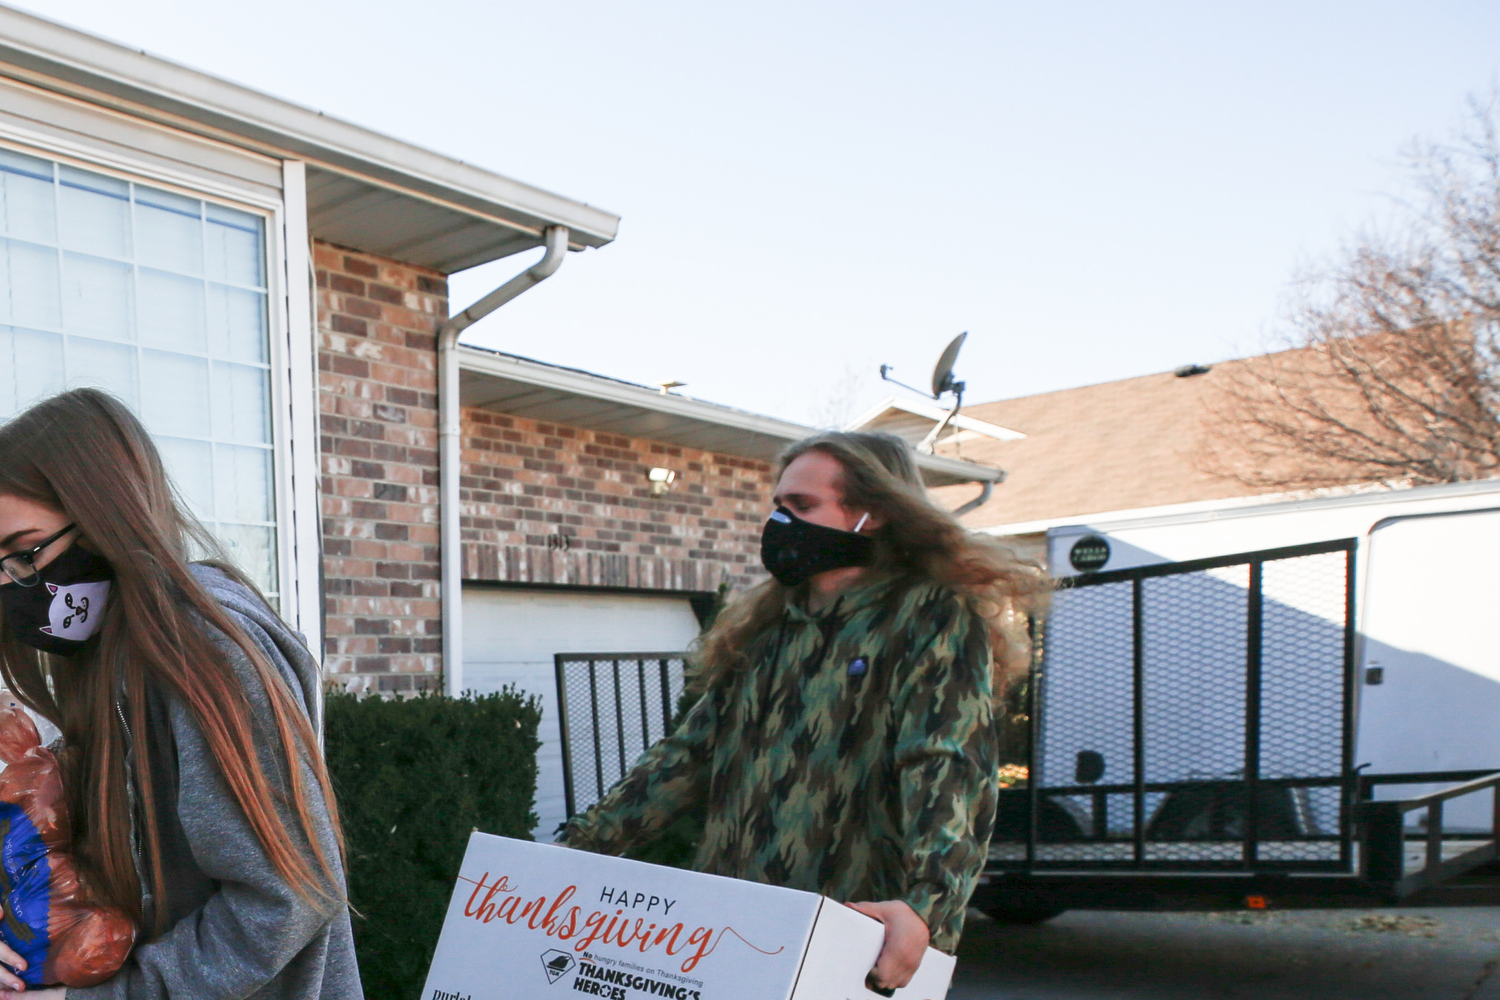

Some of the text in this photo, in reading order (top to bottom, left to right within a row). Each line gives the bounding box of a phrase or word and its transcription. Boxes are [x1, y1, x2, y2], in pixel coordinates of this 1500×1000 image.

[600, 886, 676, 916] HAPPY
[458, 872, 784, 973] thanksgiving
[583, 951, 593, 959] No
[594, 954, 617, 966] hungry
[618, 960, 644, 973] families
[657, 969, 704, 988] Thanksgiving
